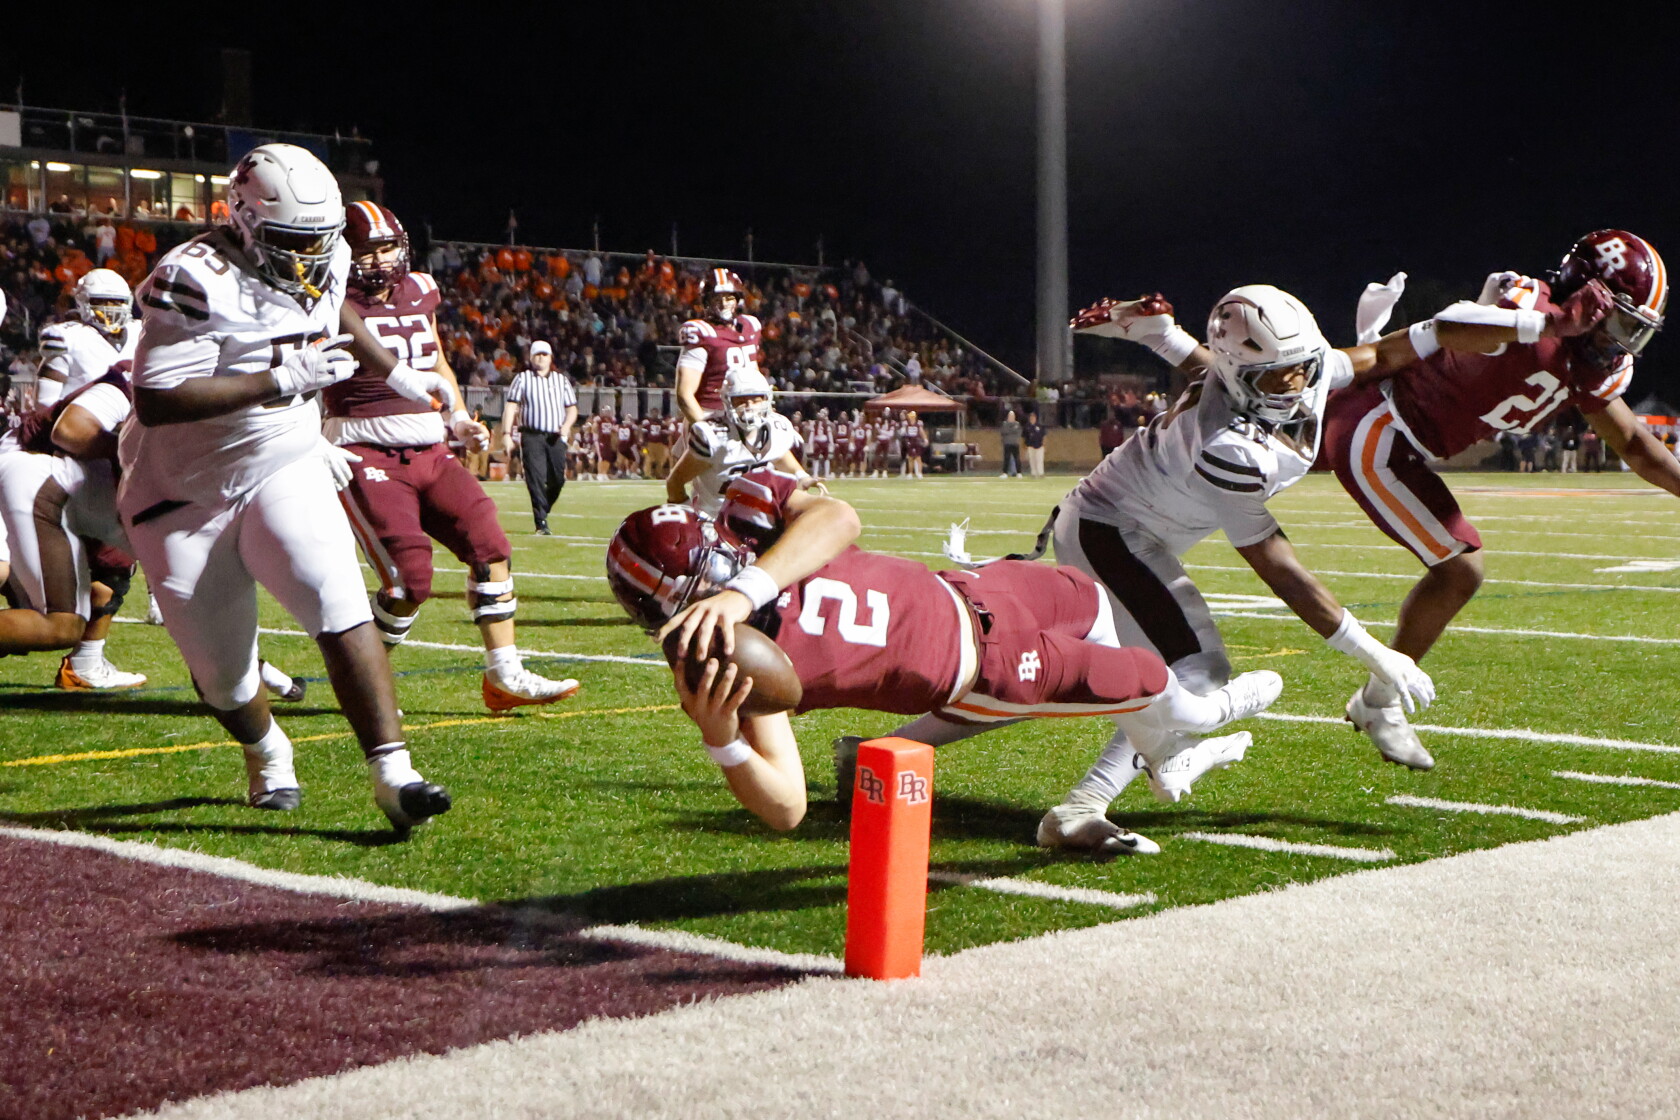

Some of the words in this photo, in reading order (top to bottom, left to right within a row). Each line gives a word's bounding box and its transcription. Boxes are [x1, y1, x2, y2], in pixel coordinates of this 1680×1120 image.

[1595, 236, 1627, 279] BR
[364, 314, 438, 369] 52
[1479, 370, 1570, 435] 21
[363, 466, 390, 482] BR
[798, 576, 891, 648] 2
[1018, 649, 1042, 682] BR
[859, 766, 885, 804] BR
[898, 771, 928, 804] BR
